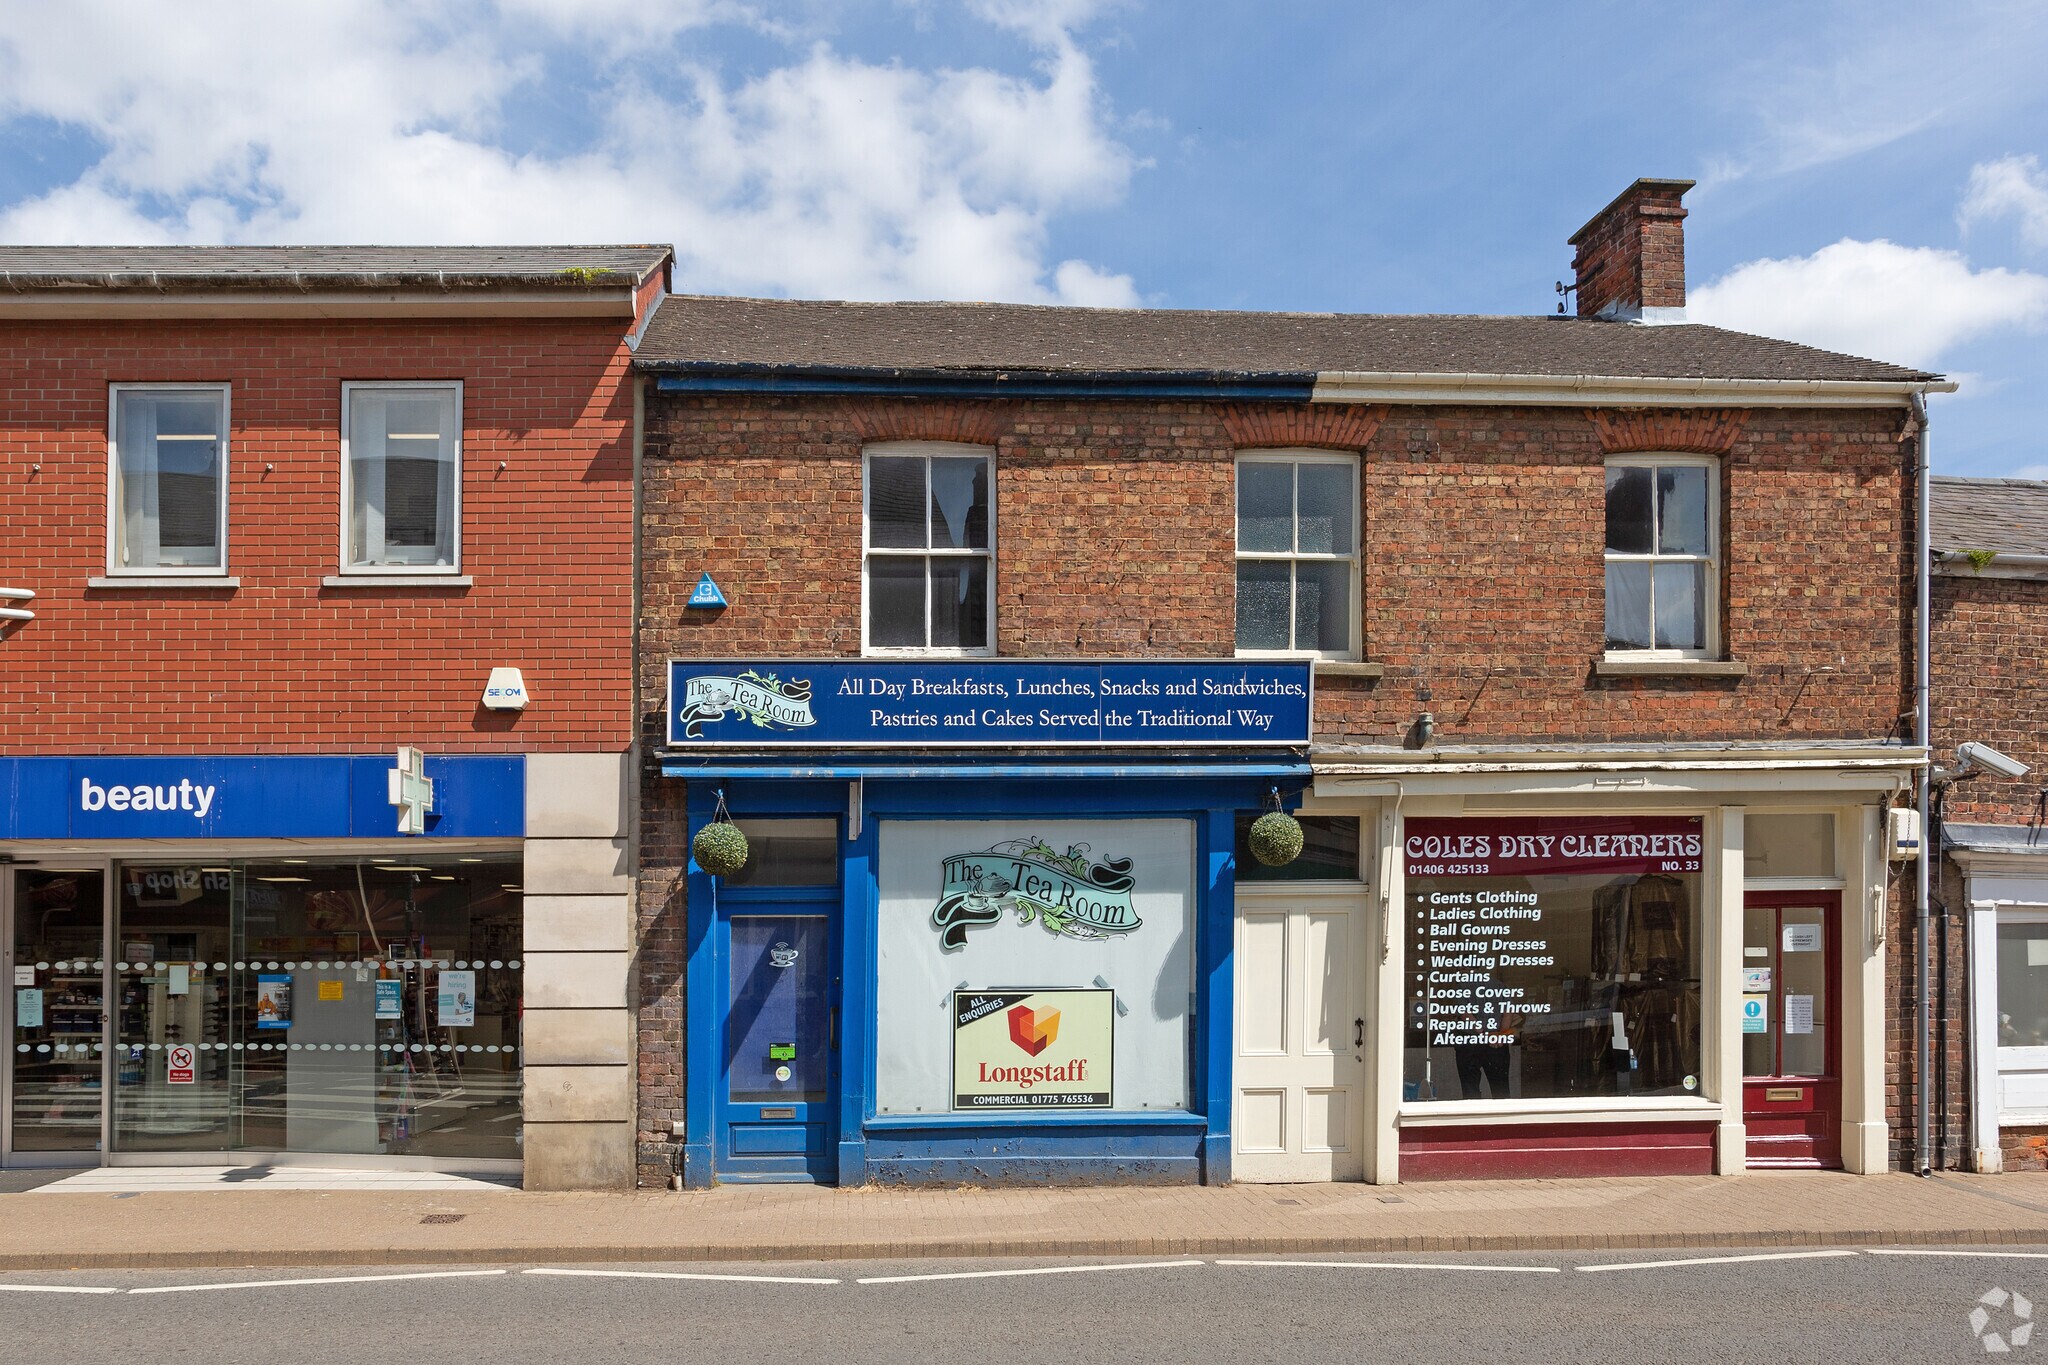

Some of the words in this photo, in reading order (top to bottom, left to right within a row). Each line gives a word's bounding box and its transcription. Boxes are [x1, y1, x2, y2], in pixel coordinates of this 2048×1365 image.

[488, 688, 520, 696] SECOM
[837, 678, 863, 696] All
[870, 678, 906, 700] Day
[911, 678, 1008, 699] Breakfasts,
[1016, 678, 1096, 699] Lunches,
[1100, 678, 1160, 696] Snacks
[1166, 678, 1198, 696] and
[1202, 678, 1307, 699] Sandwiches,
[690, 680, 713, 698] The
[730, 682, 760, 708] Tea
[763, 699, 806, 723] Room
[870, 710, 938, 727] Pastries
[944, 710, 976, 726] and
[982, 710, 1034, 726] Cakes
[1039, 710, 1099, 726] Served
[1104, 710, 1132, 726] the
[1137, 710, 1232, 726] Traditional
[1237, 710, 1274, 730] Way
[82, 778, 216, 818] beauty
[1406, 835, 1491, 859] COLES
[1498, 835, 1556, 858] DRY
[1560, 834, 1702, 858] CLEANERS
[1409, 864, 1444, 874] 01406
[1447, 864, 1490, 874] 425133
[1662, 861, 1682, 872] NO.
[1686, 860, 1700, 871] 33
[947, 859, 984, 884] The
[1010, 862, 1052, 902] Tea
[1058, 880, 1126, 924] Room
[1430, 892, 1472, 904] Gents
[1476, 891, 1538, 906] Clothing
[1430, 908, 1476, 920] Ladies
[1480, 907, 1542, 922] Clothing
[1430, 924, 1457, 936] Ball
[1461, 924, 1510, 936] Gowns
[1430, 939, 1488, 953] Evening
[1492, 939, 1546, 950] Dresses
[1430, 955, 1496, 970] Wedding
[1500, 955, 1554, 966] Dresses
[1430, 970, 1490, 982] Curtains
[1430, 987, 1472, 998] Loose
[1475, 986, 1524, 998] Covers
[970, 996, 987, 1008] ALL
[1429, 1002, 1480, 1014] Duvets
[1484, 1002, 1494, 1014] &
[1498, 1002, 1550, 1014] Throws
[959, 998, 1004, 1024] ENQUIRIES
[1429, 1018, 1482, 1033] Repairs
[1486, 1018, 1498, 1030] &
[1434, 1032, 1514, 1045] Alterations
[978, 1059, 1087, 1089] Longstaff
[973, 1096, 1029, 1105] COMMERCIAL
[1032, 1095, 1058, 1104] 01775
[1062, 1095, 1093, 1104] 765536
